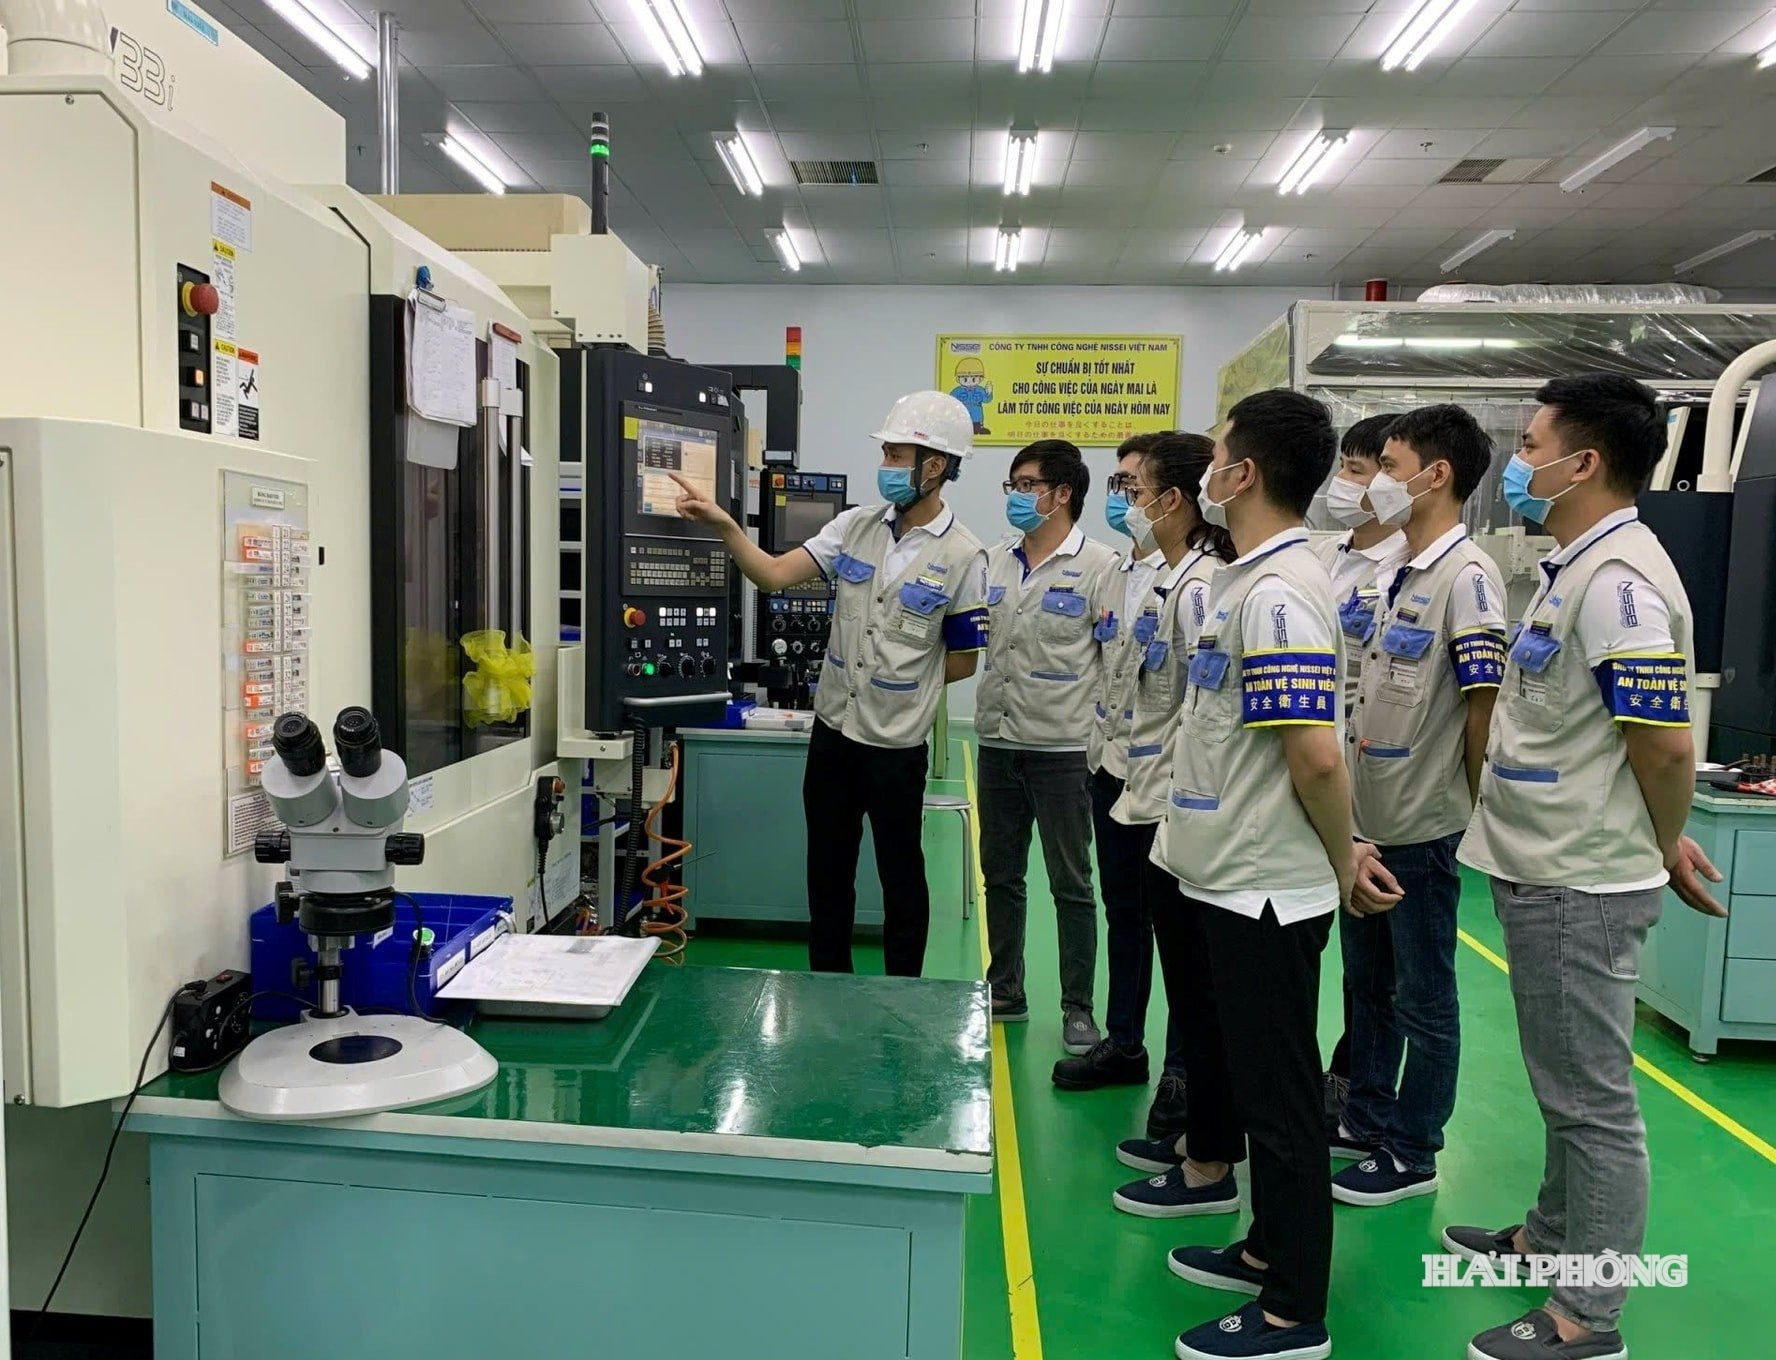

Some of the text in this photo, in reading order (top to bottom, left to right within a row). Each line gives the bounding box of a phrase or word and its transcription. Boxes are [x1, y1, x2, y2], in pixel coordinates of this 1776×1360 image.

[989, 342, 1012, 351] CÔNG
[1015, 343, 1025, 351] TY
[1027, 343, 1049, 351] TNHH
[1050, 342, 1074, 351] CÔNG
[1100, 343, 1127, 351] NISSEI
[1036, 361, 1049, 377] SỰ
[1082, 362, 1092, 377] BỊ
[1094, 358, 1110, 374] TỐT
[1112, 358, 1135, 374] NHẤT
[1012, 379, 1157, 397] CHO CÔNG VIỆC CỦA NGÀY MAI LÀ
[998, 398, 1171, 417] LÀM TỐT CÔNG VIỆC CỦA NGÀY HÔM NAY
[1274, 604, 1289, 648] NISSE
[1459, 652, 1470, 664] AN
[1471, 648, 1494, 660] TOÀN
[1264, 664, 1280, 674] CÔNG
[1281, 664, 1299, 674] NGHỆ
[1300, 665, 1320, 674] NISSEI
[1254, 678, 1273, 692] TOÀN
[1275, 676, 1288, 692] VỆ
[1290, 678, 1316, 690] SINH
[1617, 676, 1634, 688] AN
[1637, 677, 1666, 690] TOÀN
[1667, 678, 1678, 694] VỆ
